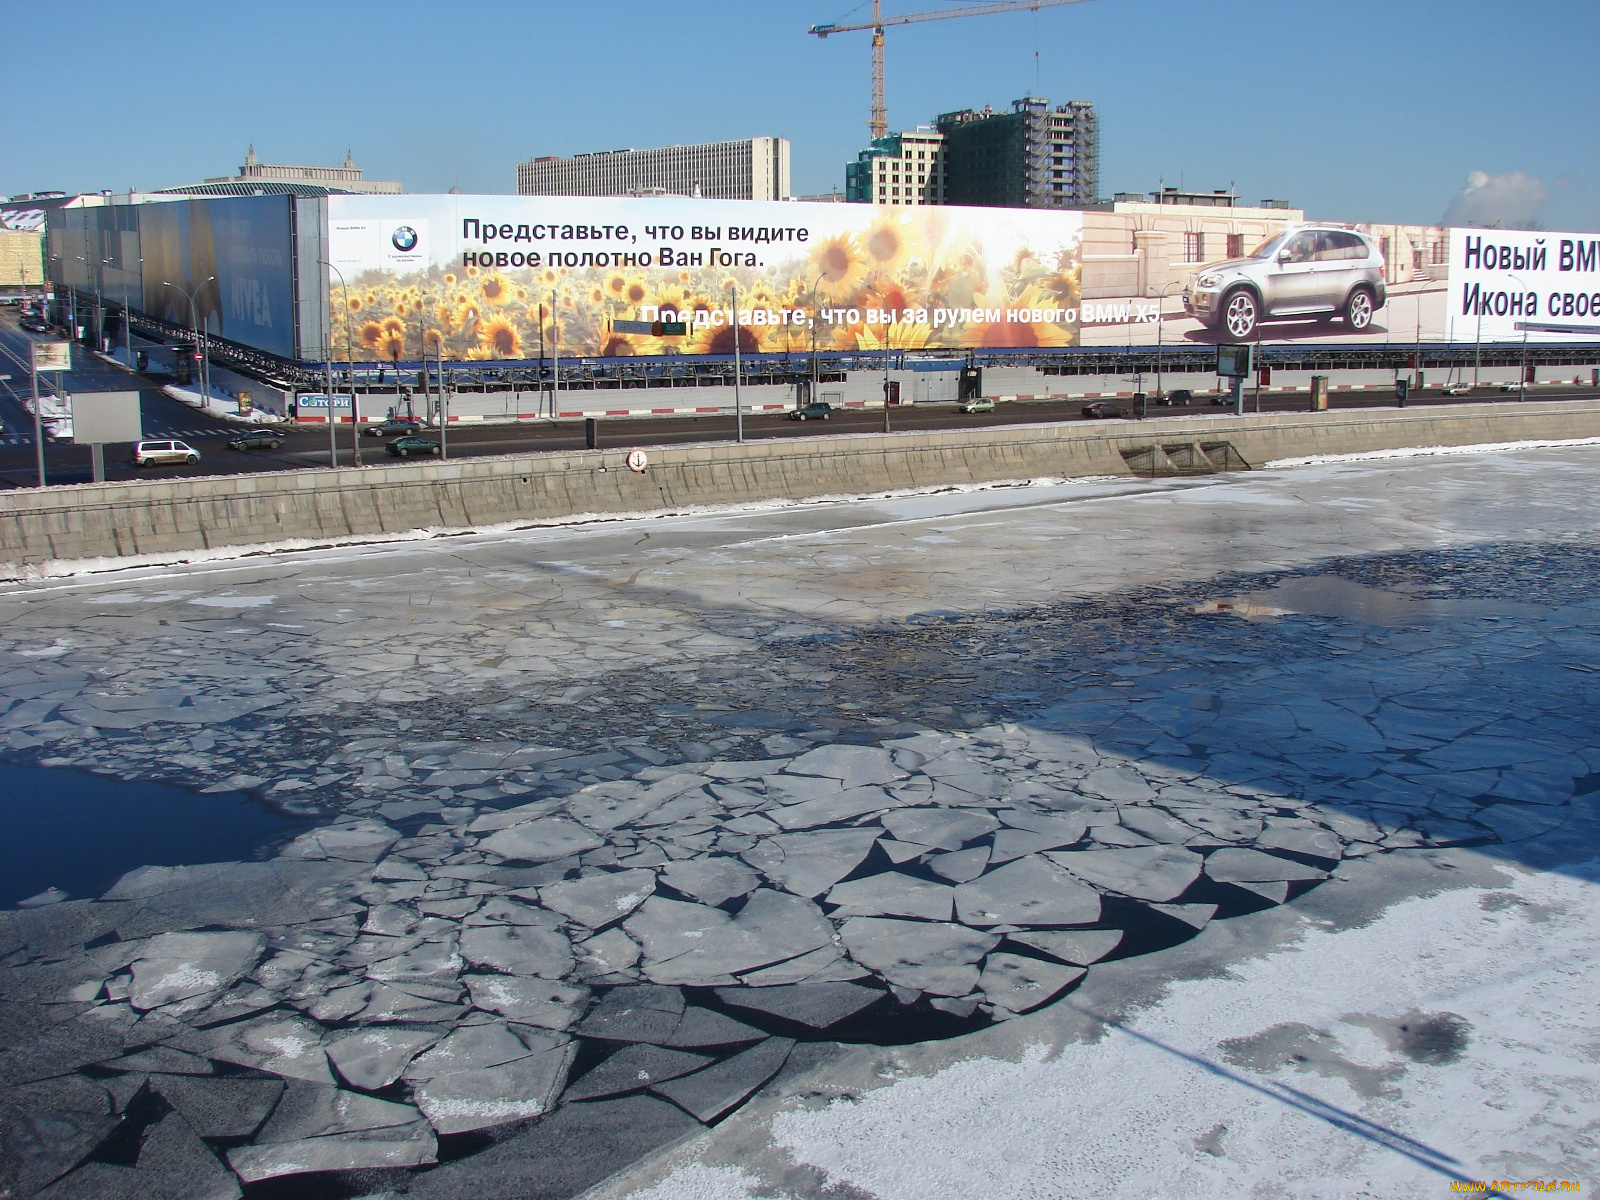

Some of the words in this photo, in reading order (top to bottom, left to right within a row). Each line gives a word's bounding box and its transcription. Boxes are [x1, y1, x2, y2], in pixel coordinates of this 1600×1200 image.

[463, 218, 637, 244] Представьте,
[645, 225, 684, 240] что
[691, 225, 722, 241] вы
[728, 226, 809, 243] видите
[463, 251, 541, 267] новое
[548, 251, 652, 267] полотно
[659, 248, 702, 267] Ван
[709, 248, 764, 268] Гога.
[1464, 235, 1547, 271] Новый
[1462, 282, 1538, 317] Икона
[821, 308, 860, 325] что
[866, 308, 897, 324] вы
[902, 308, 928, 324] за
[934, 308, 1001, 328] рулем
[1006, 307, 1077, 323] нового
[1081, 303, 1131, 323] BMW
[1135, 303, 1164, 323] X5.
